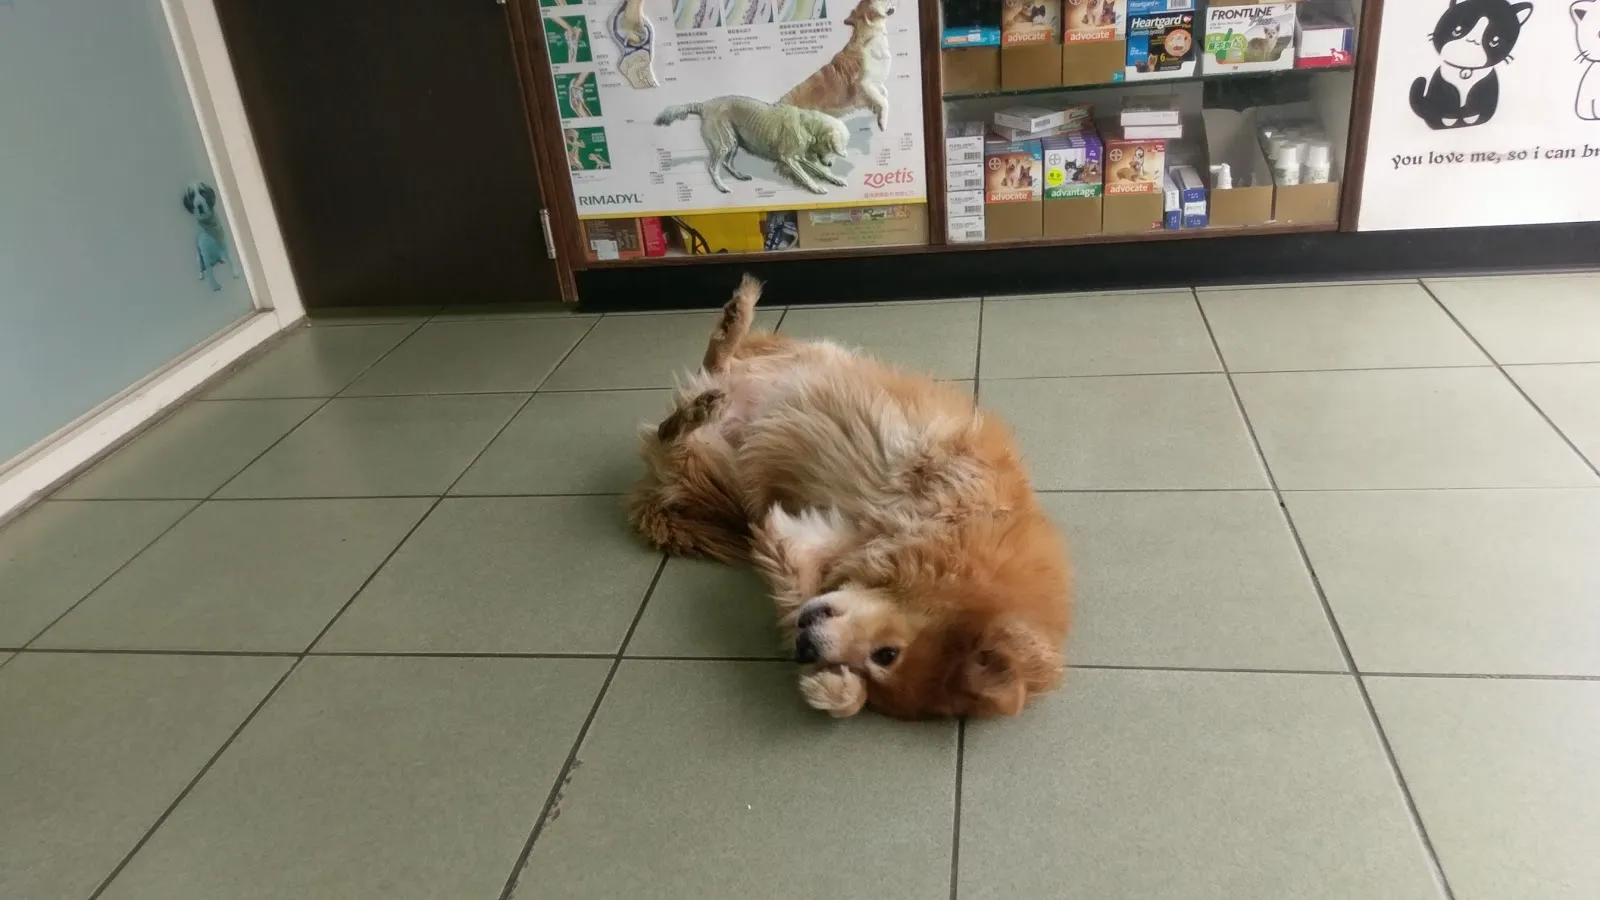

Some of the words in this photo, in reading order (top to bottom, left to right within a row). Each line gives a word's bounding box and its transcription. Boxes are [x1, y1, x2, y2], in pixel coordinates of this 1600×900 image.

[1211, 6, 1273, 21] FRONTLINE
[1131, 14, 1182, 29] Heartgard
[1008, 31, 1046, 42] advocate
[1069, 30, 1110, 41] advocate
[1159, 53, 1166, 62] 6
[1391, 153, 1423, 170] you
[1428, 151, 1465, 164] love
[1470, 151, 1502, 163] me,
[1507, 148, 1528, 161] so
[1533, 146, 1540, 159] i
[1545, 148, 1577, 159] can
[863, 167, 915, 188] zoetis
[1051, 186, 1096, 198] advantage
[1110, 182, 1148, 194] advocate
[579, 193, 643, 206] RIMADYL
[991, 192, 1028, 202] advocate
